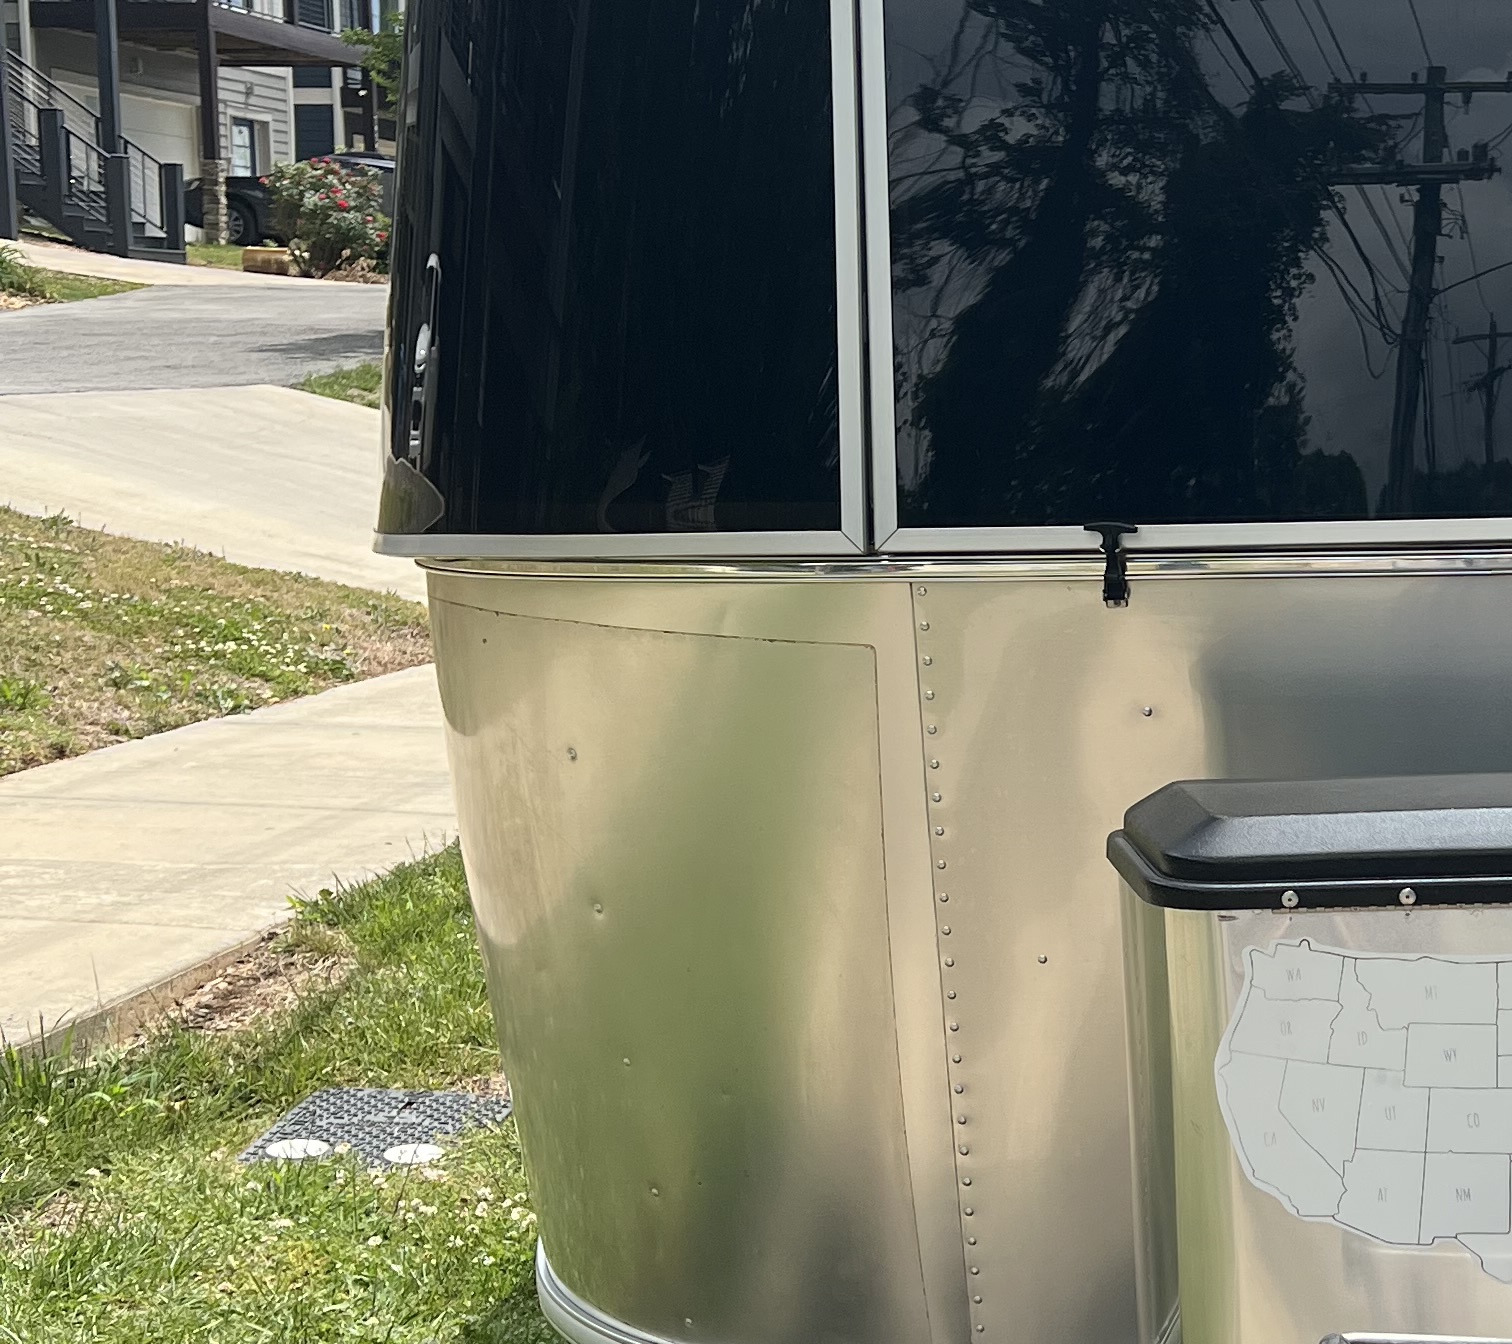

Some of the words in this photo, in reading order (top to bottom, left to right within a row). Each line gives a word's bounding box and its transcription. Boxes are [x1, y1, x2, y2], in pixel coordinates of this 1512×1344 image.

[1285, 968, 1302, 982] WA
[1279, 1020, 1293, 1036] OR
[1356, 1031, 1368, 1046] ID
[1311, 1097, 1326, 1113] NV
[1384, 1105, 1398, 1121] UT
[1466, 1112, 1481, 1129] CO
[1263, 1131, 1278, 1148] CA
[1455, 1187, 1472, 1202] NM
